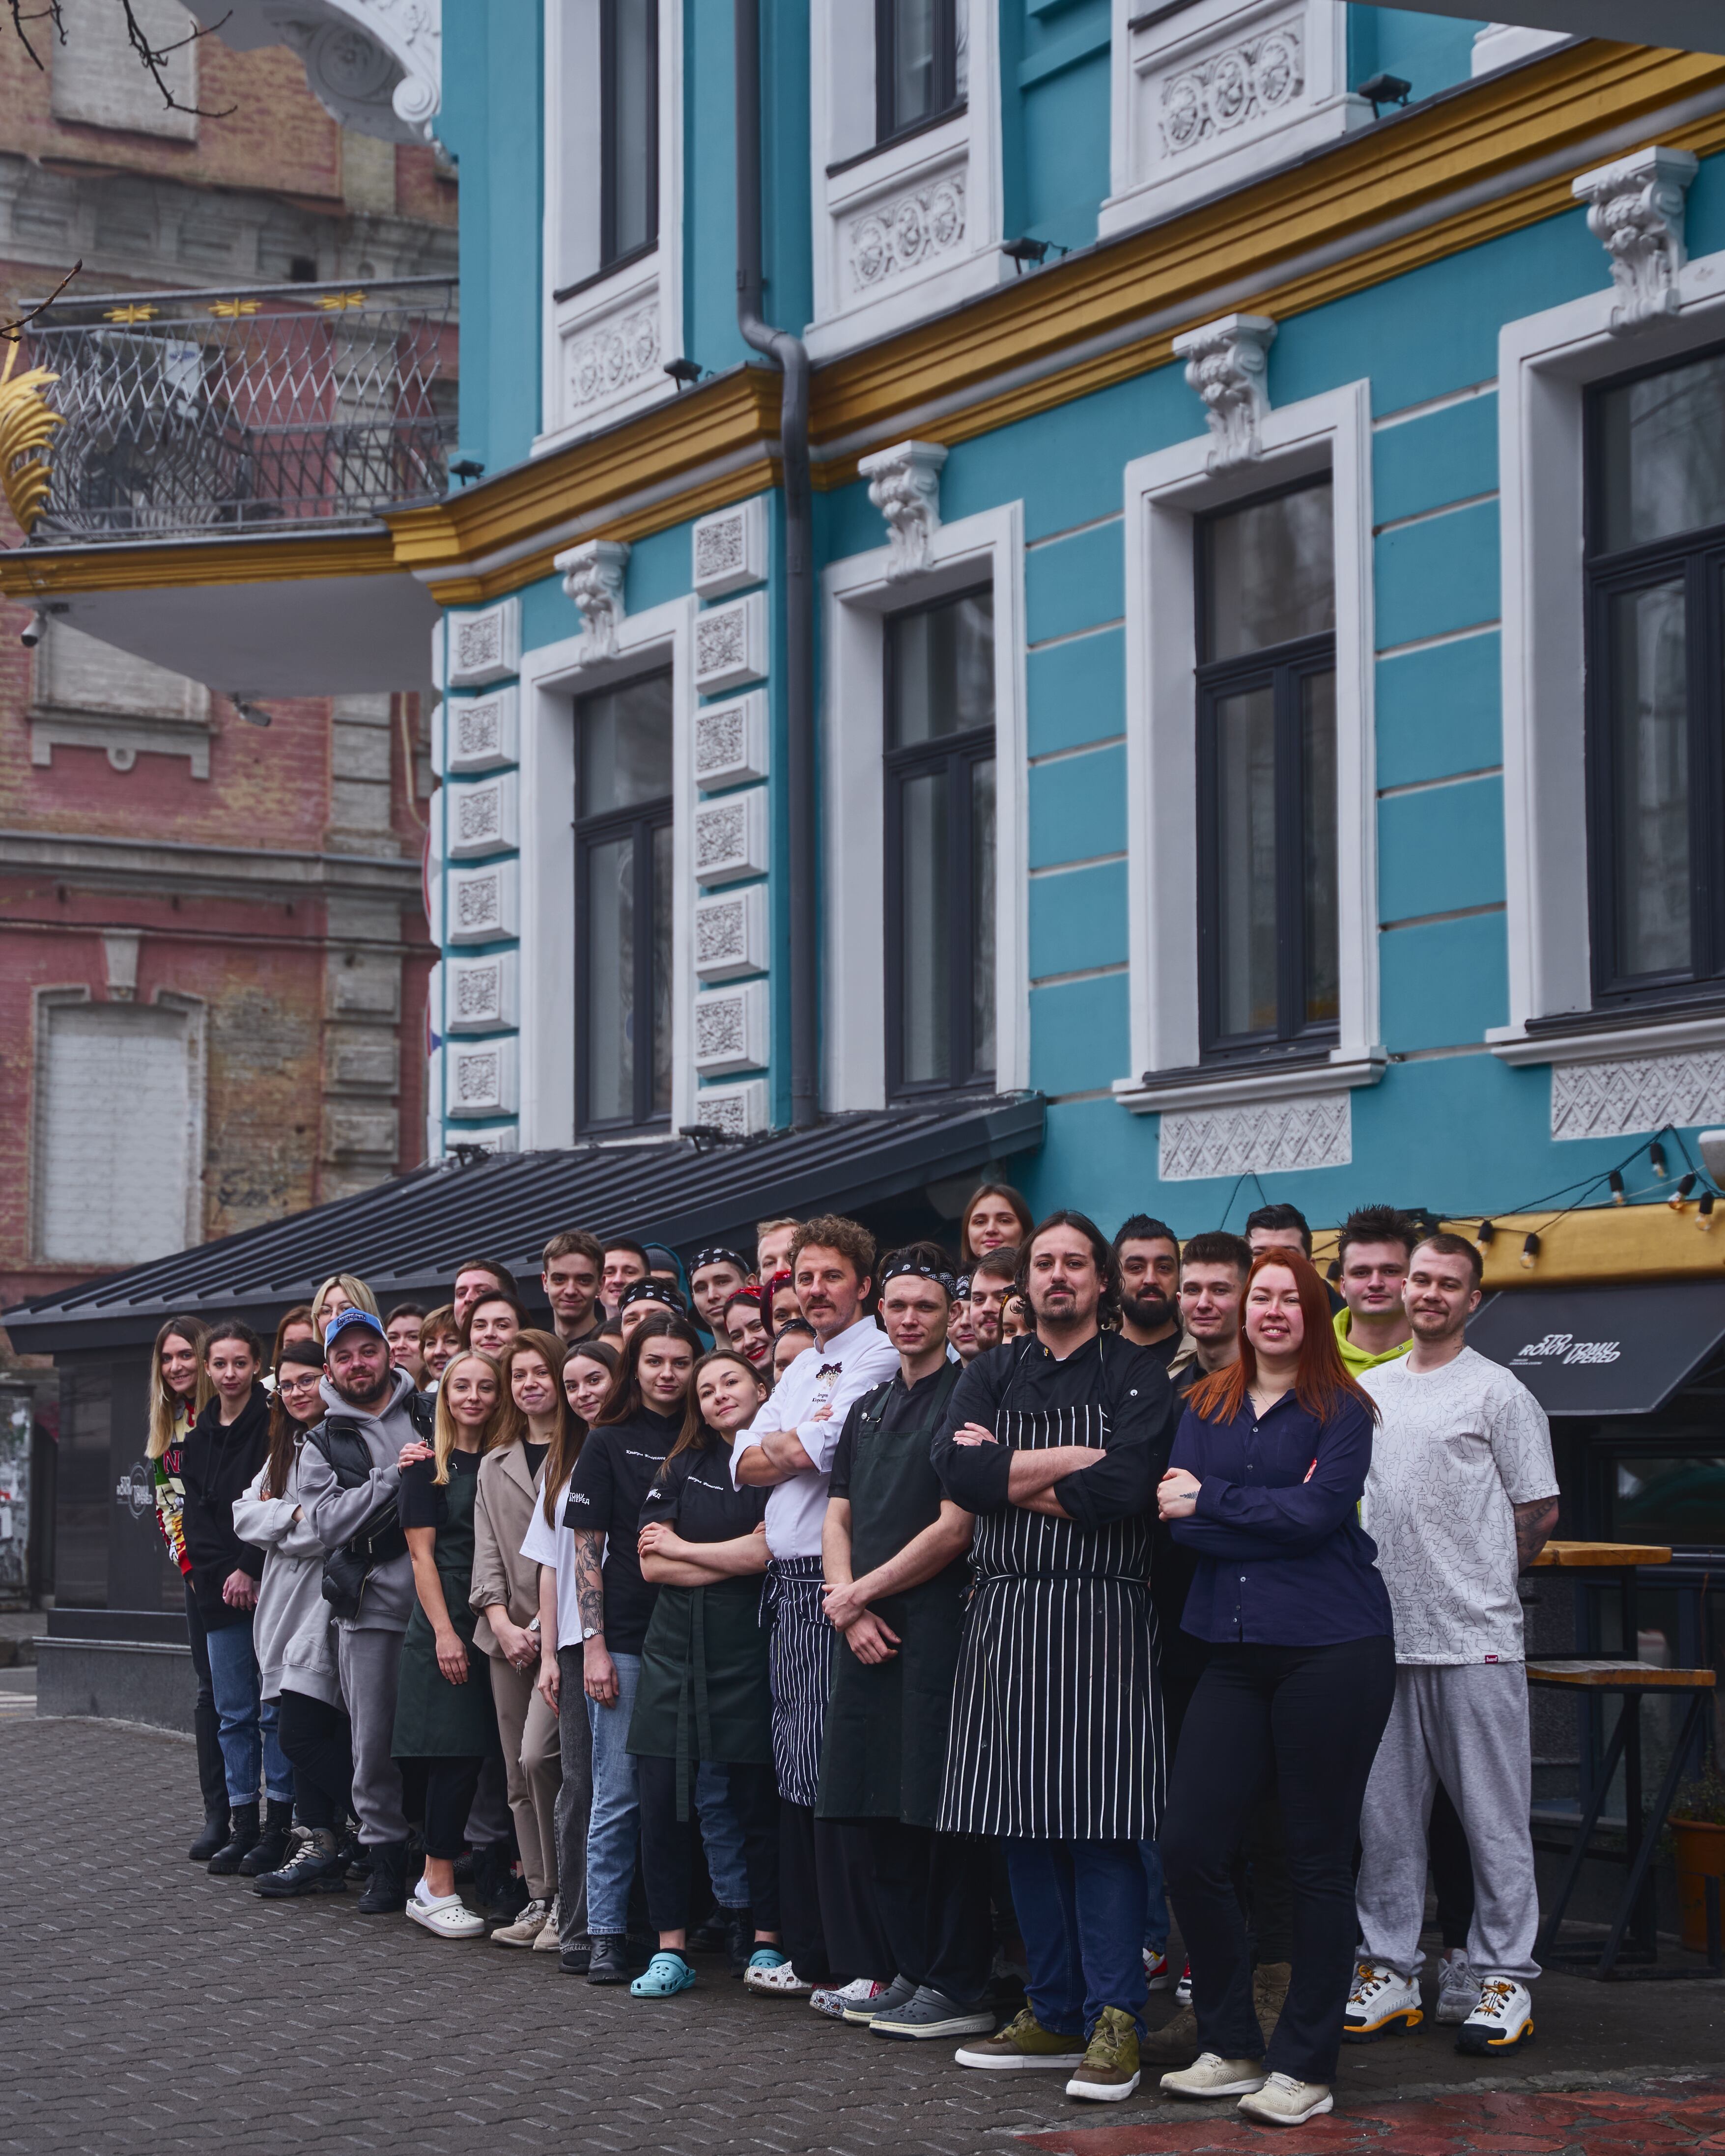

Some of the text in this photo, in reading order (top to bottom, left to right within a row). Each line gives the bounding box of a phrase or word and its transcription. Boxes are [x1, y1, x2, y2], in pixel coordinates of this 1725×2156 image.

[1543, 1334, 1573, 1345] STO
[1518, 1342, 1620, 1356] ROKIV TOMU
[1562, 1351, 1621, 1364] VPERED
